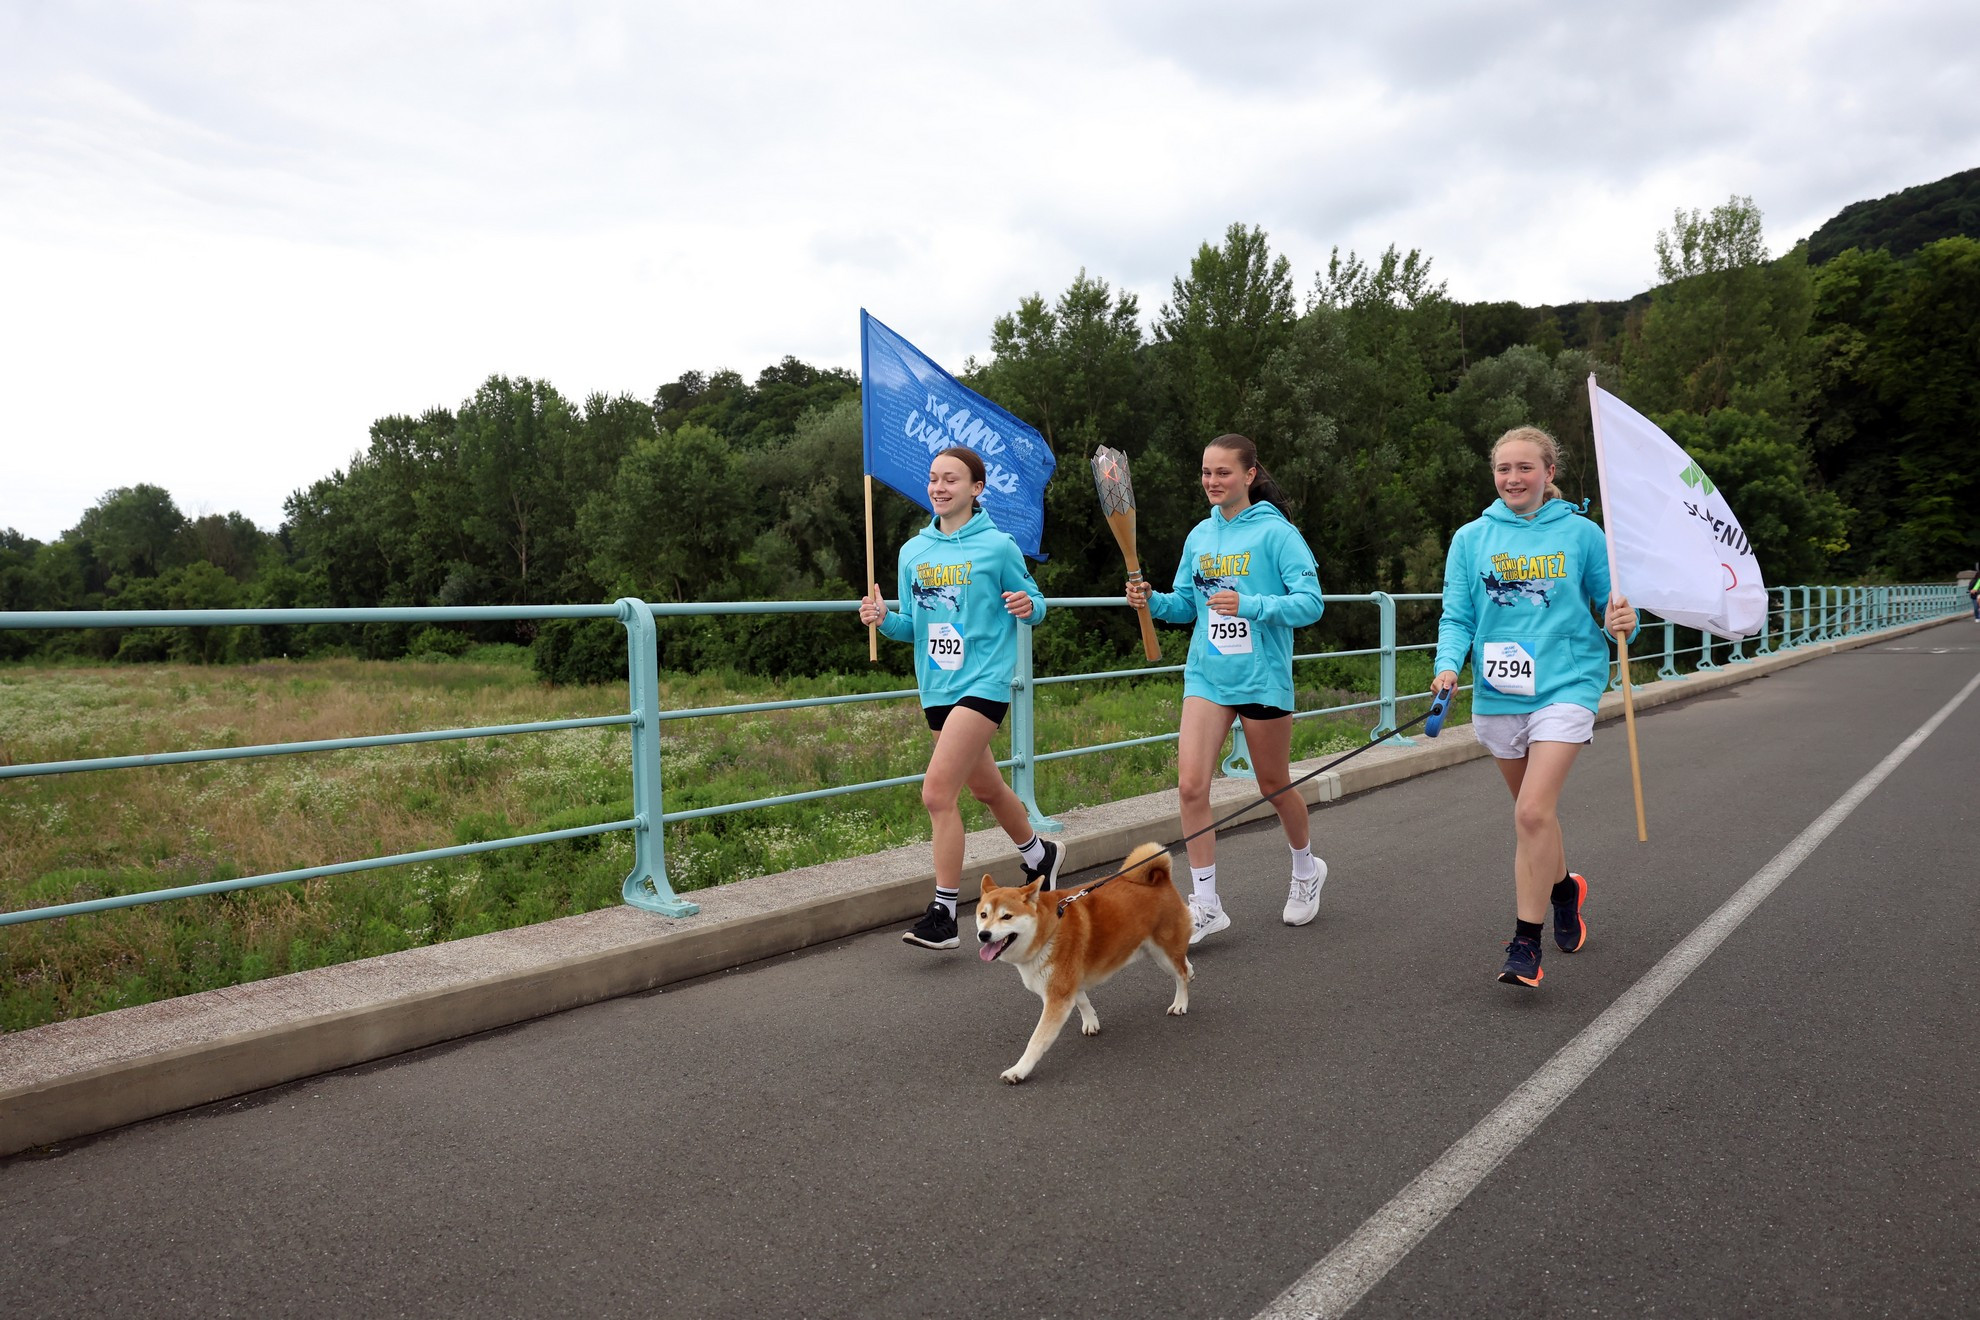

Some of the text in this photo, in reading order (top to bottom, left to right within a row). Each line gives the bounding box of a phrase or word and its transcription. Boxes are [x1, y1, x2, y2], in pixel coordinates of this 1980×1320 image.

[1495, 558, 1517, 572] KANU
[1517, 551, 1567, 581] ČATEŽ
[1502, 570, 1519, 581] KLUB
[1211, 622, 1248, 640] 7593
[930, 639, 961, 655] 7592
[1486, 660, 1532, 678] 7594
